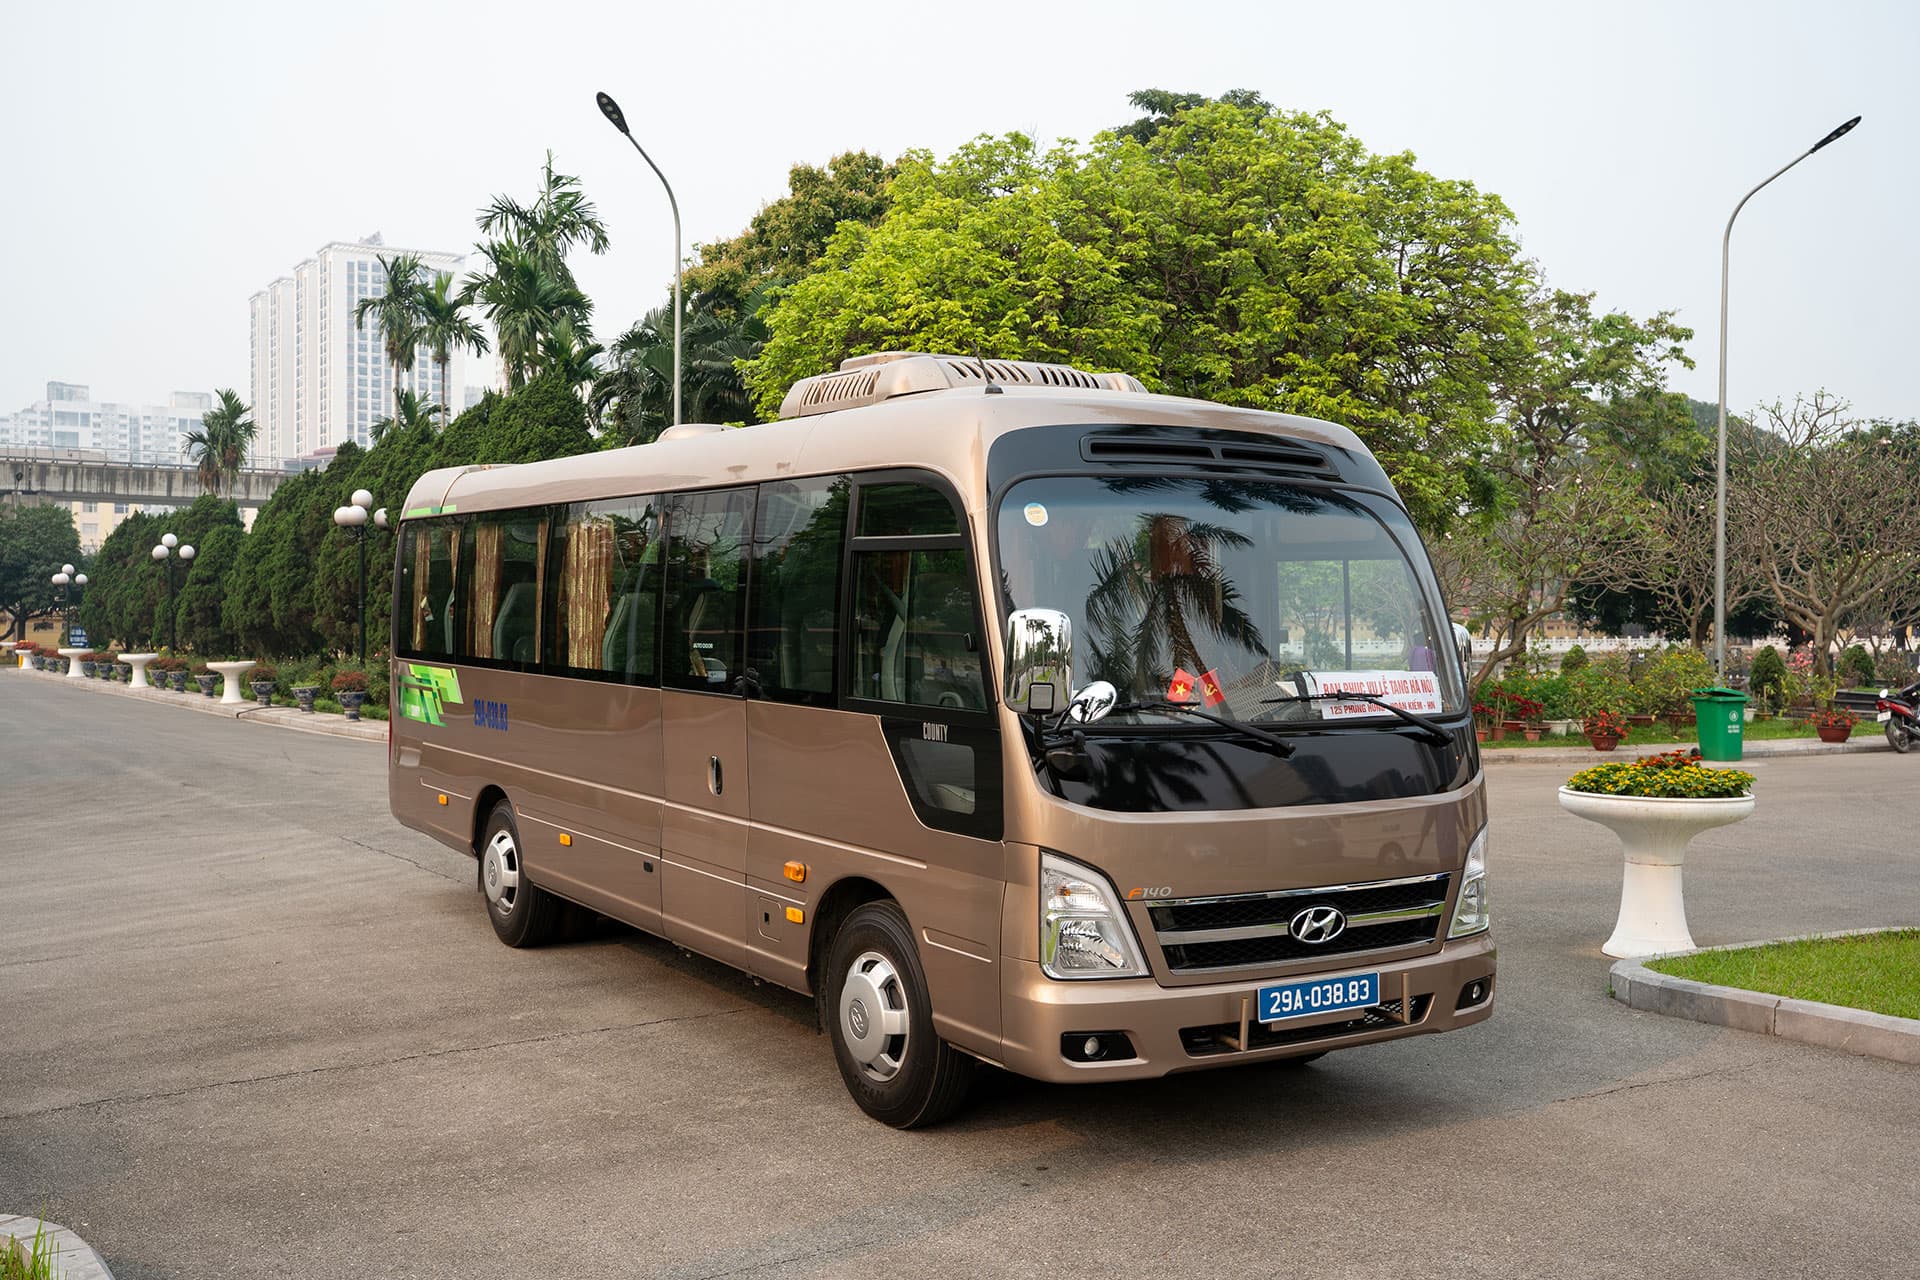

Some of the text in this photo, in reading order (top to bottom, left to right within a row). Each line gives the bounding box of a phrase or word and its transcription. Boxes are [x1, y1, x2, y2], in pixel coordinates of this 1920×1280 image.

[1389, 679, 1410, 695] TANG
[1330, 704, 1343, 715] 125
[923, 722, 948, 742] COUNTY
[1127, 886, 1172, 900] F140
[1269, 979, 1370, 1015] 29A-038.83
